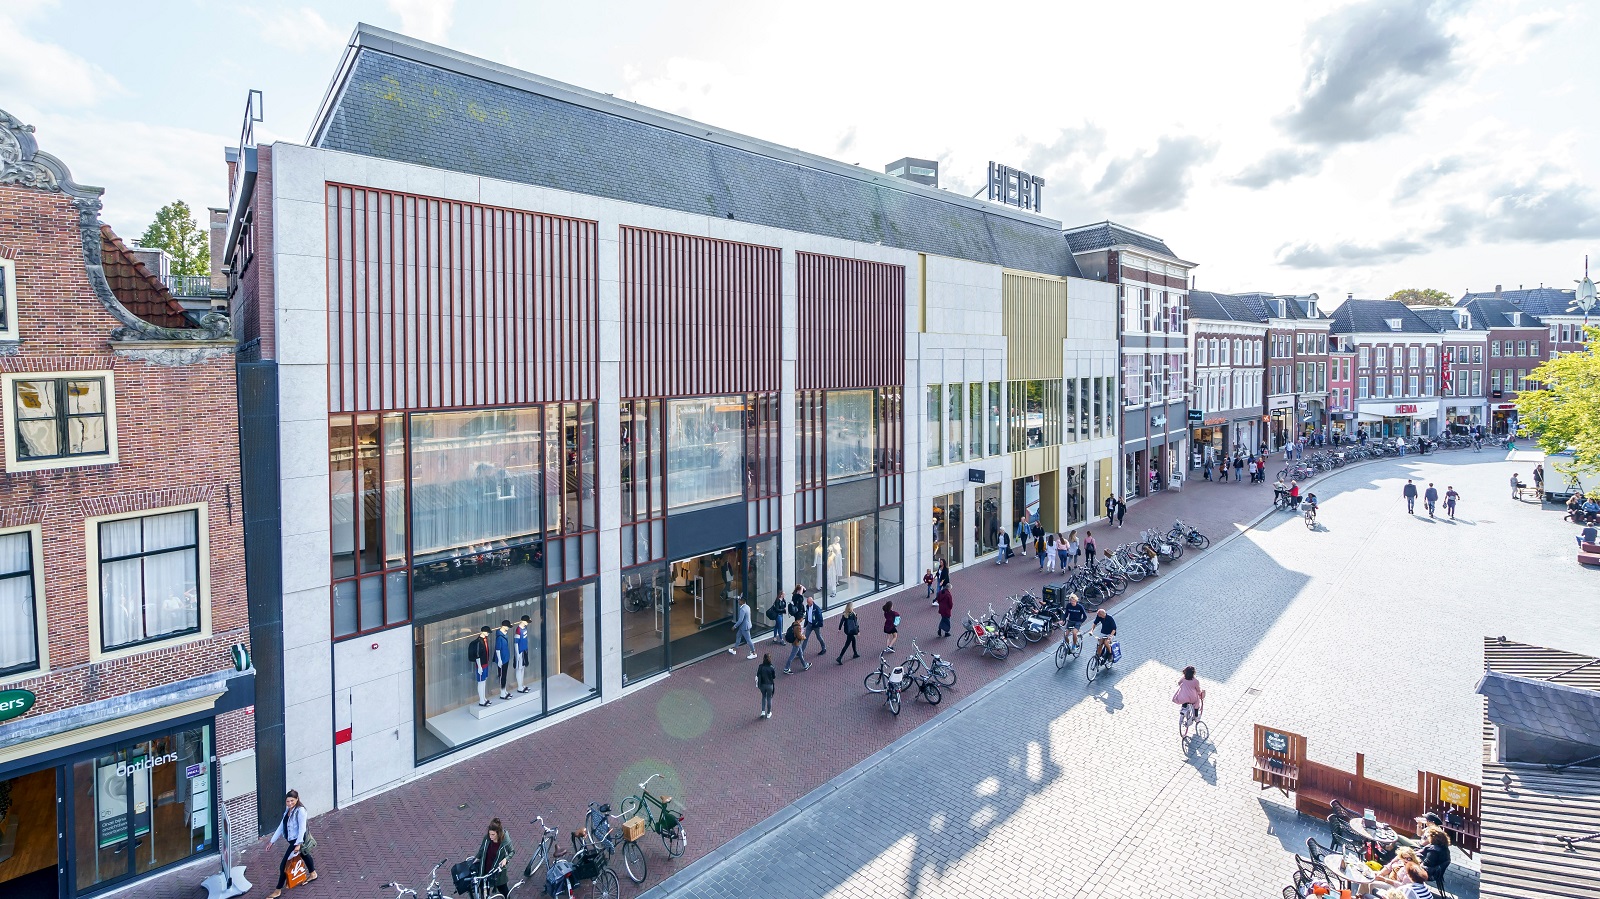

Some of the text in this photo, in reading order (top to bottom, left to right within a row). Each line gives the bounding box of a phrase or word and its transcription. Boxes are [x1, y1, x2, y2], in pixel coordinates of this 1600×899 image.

[988, 160, 1045, 213] HERT
[1441, 352, 1451, 391] HEMA
[1395, 404, 1418, 414] HEMA
[116, 751, 178, 777] Opticiens
